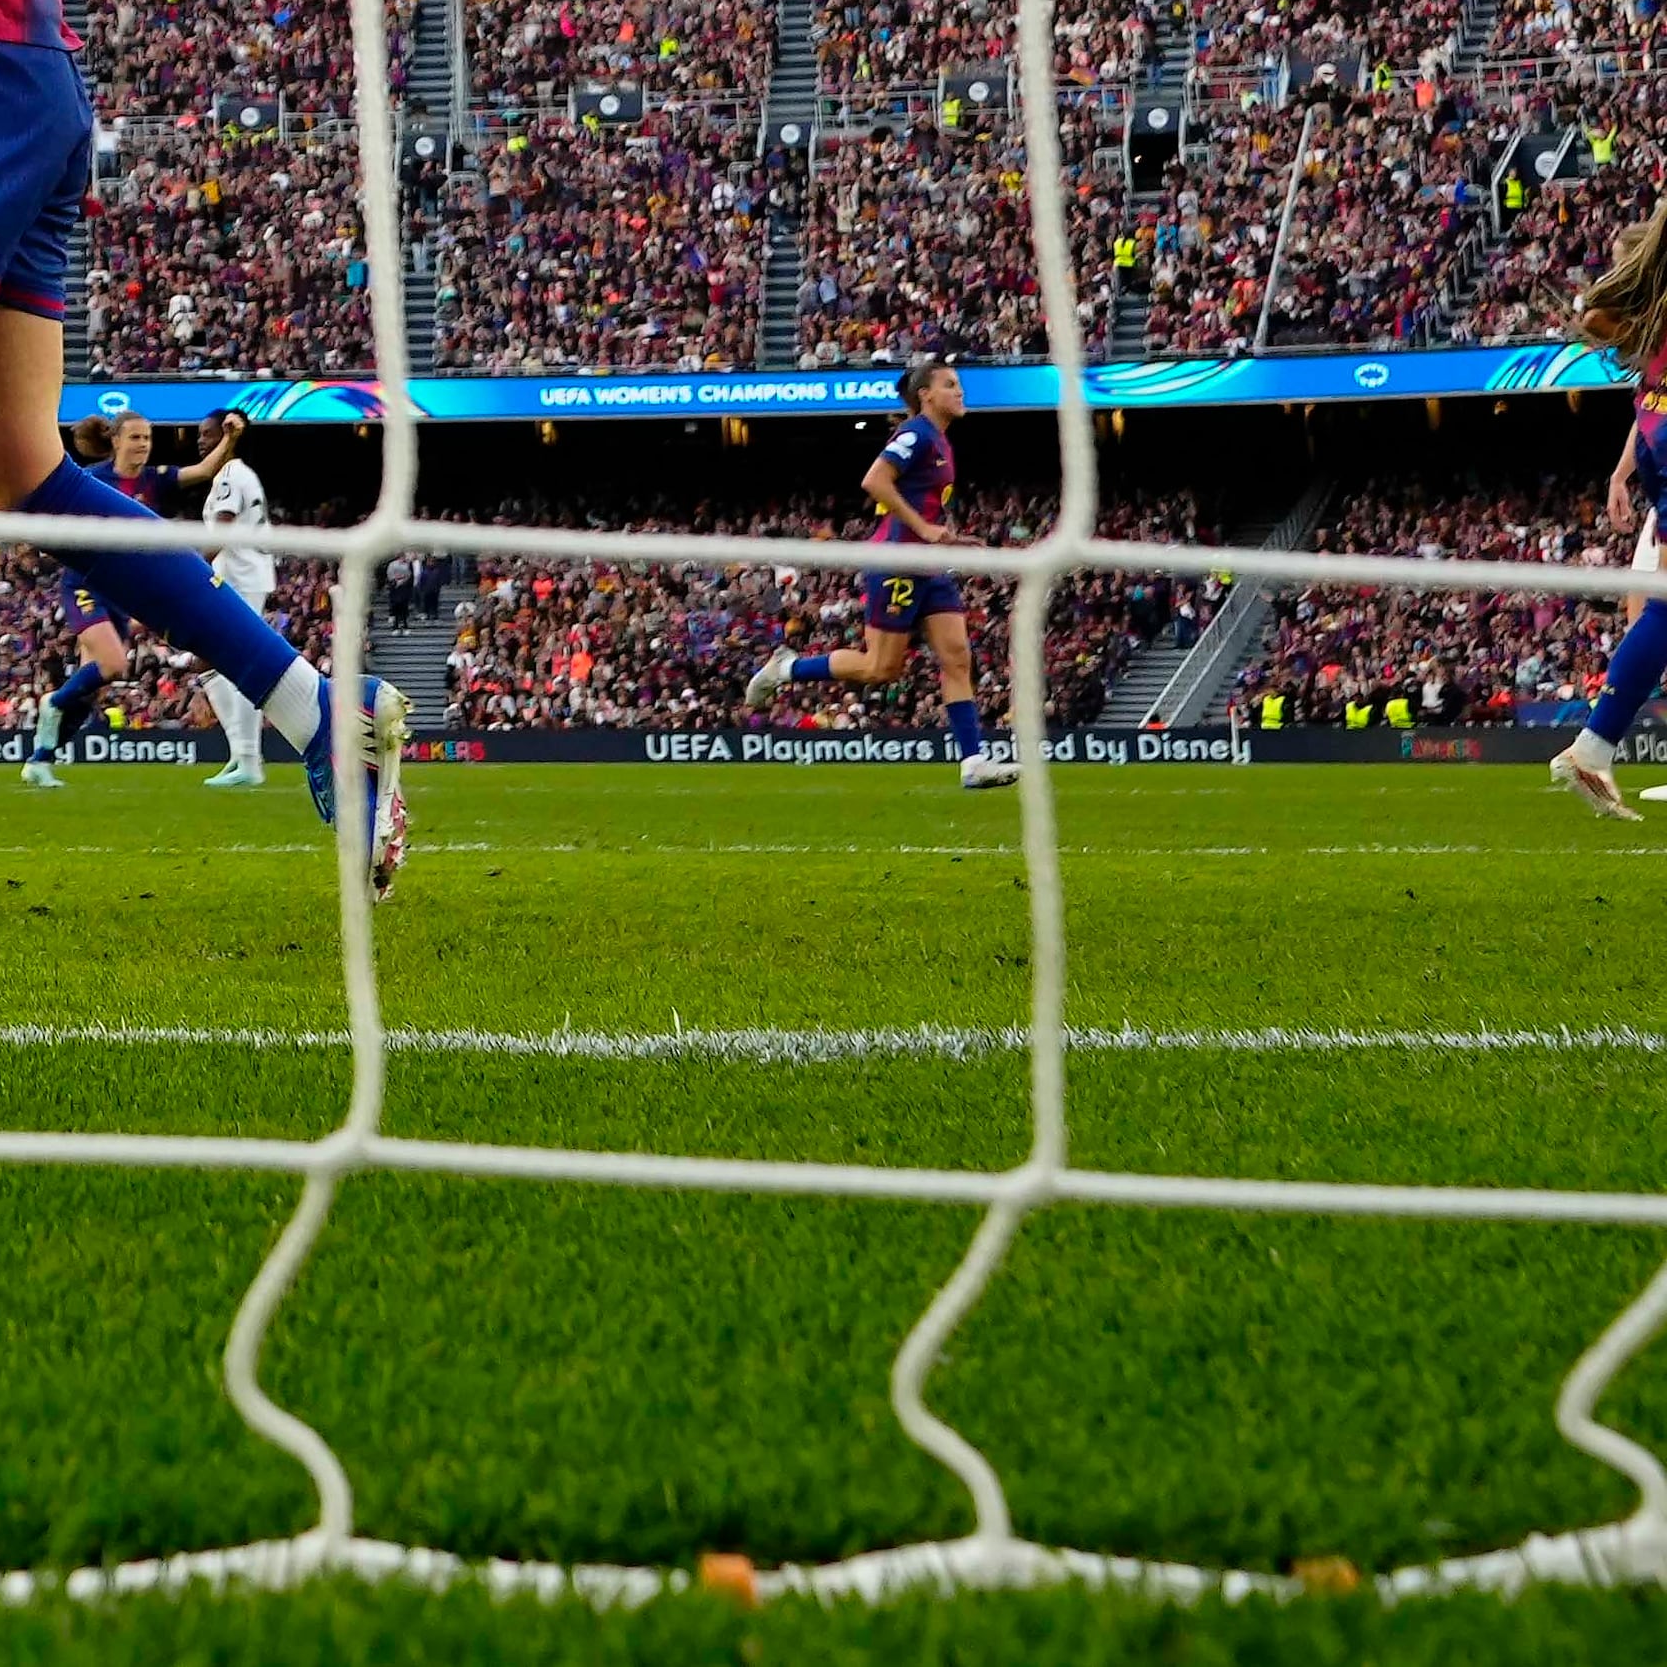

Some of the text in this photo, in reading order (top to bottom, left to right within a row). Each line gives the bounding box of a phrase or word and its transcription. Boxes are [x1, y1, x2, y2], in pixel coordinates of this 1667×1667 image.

[539, 386, 592, 406] UEFA
[697, 382, 828, 404] CHAMPIONS
[835, 380, 900, 402] LEAGU
[85, 734, 198, 765] Disney
[401, 740, 485, 761] MAKERS
[645, 734, 734, 761] UEFA
[742, 734, 935, 765] Playmakers
[1085, 733, 1127, 765] by
[1138, 734, 1253, 765] Disney
